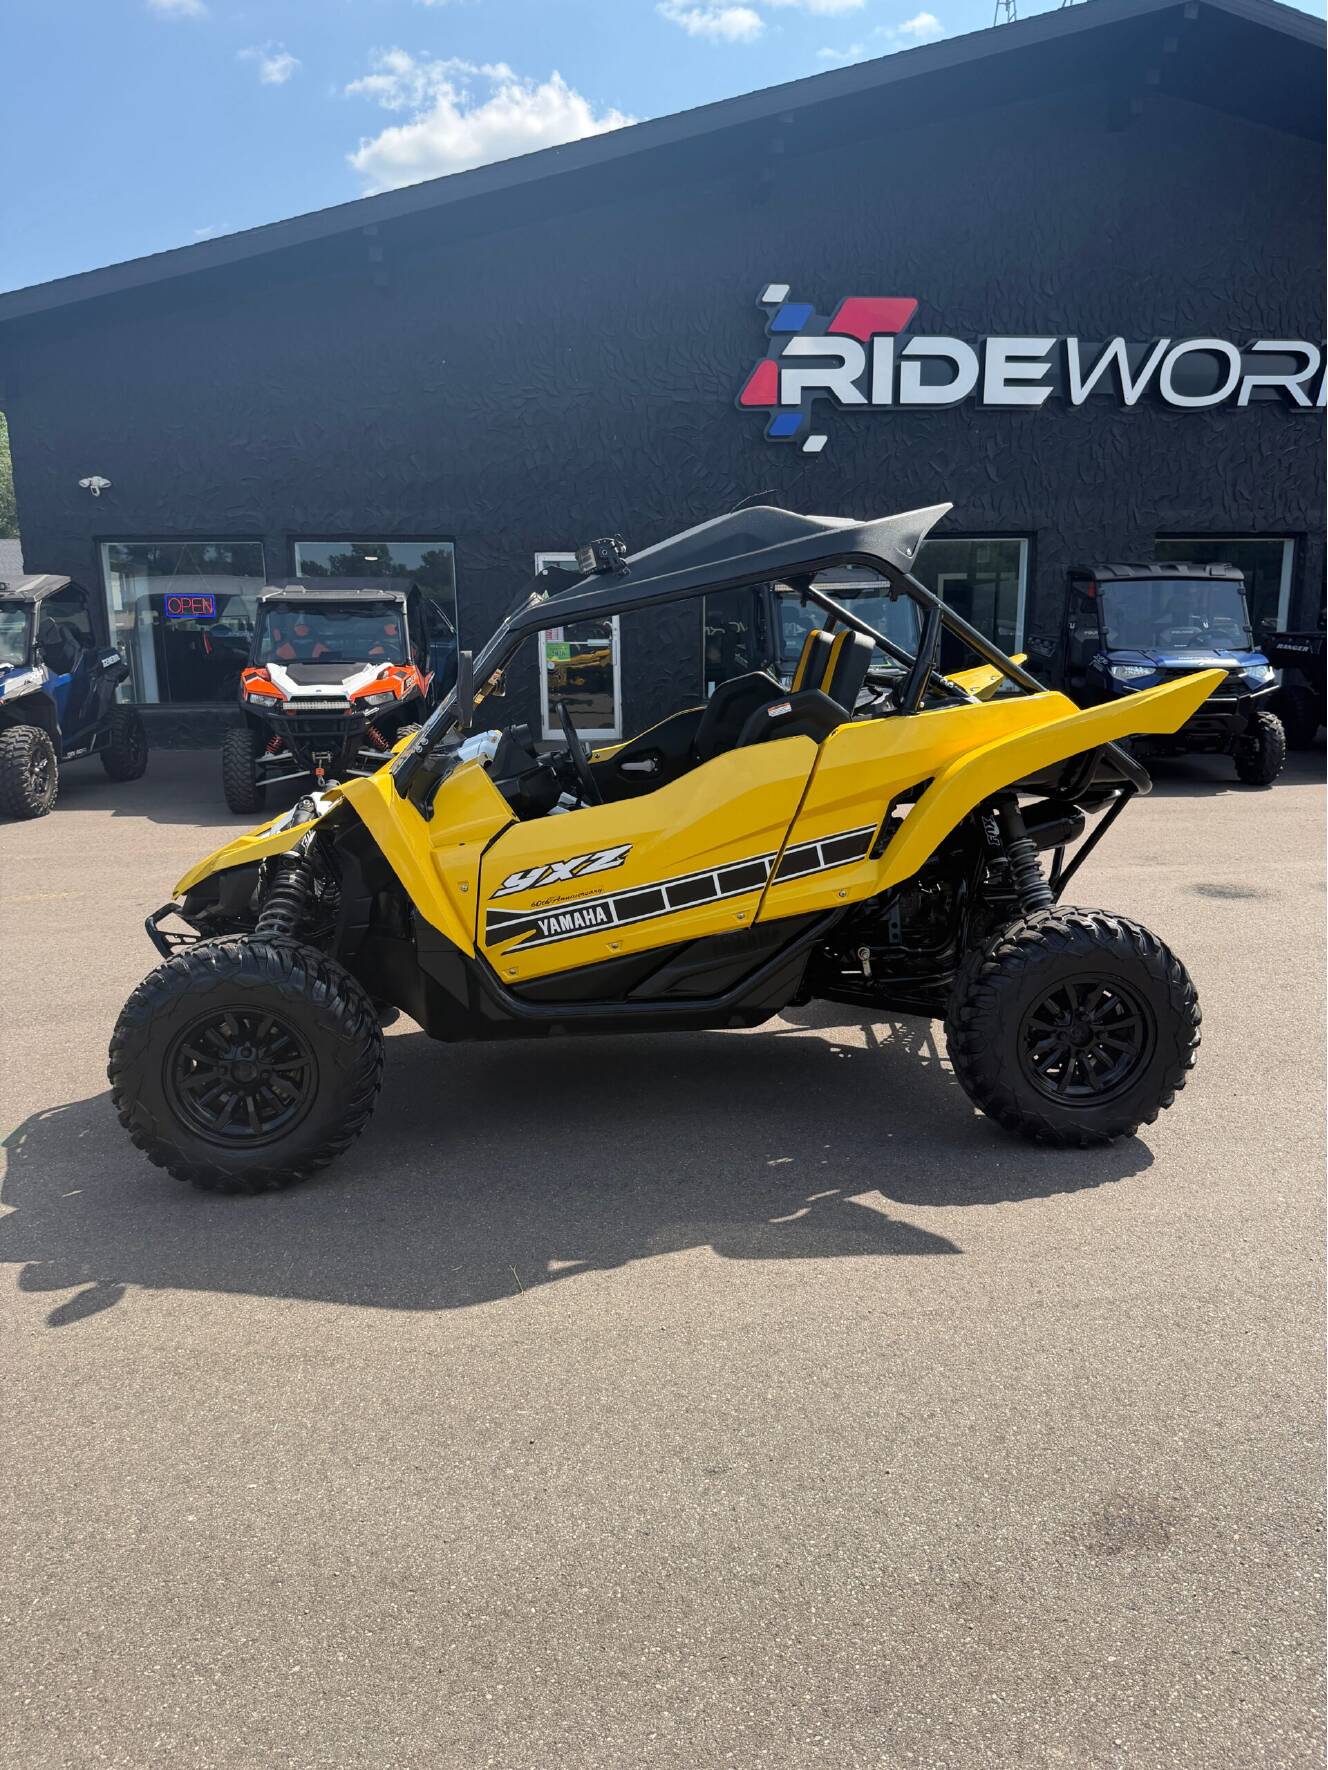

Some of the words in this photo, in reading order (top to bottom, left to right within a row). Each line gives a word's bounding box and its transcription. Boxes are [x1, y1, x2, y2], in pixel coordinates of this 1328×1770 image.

[781, 336, 1328, 407] RIDEWOR
[168, 597, 213, 614] OPEN
[1276, 643, 1310, 651] RANGER
[537, 906, 608, 937] YAMAHA
